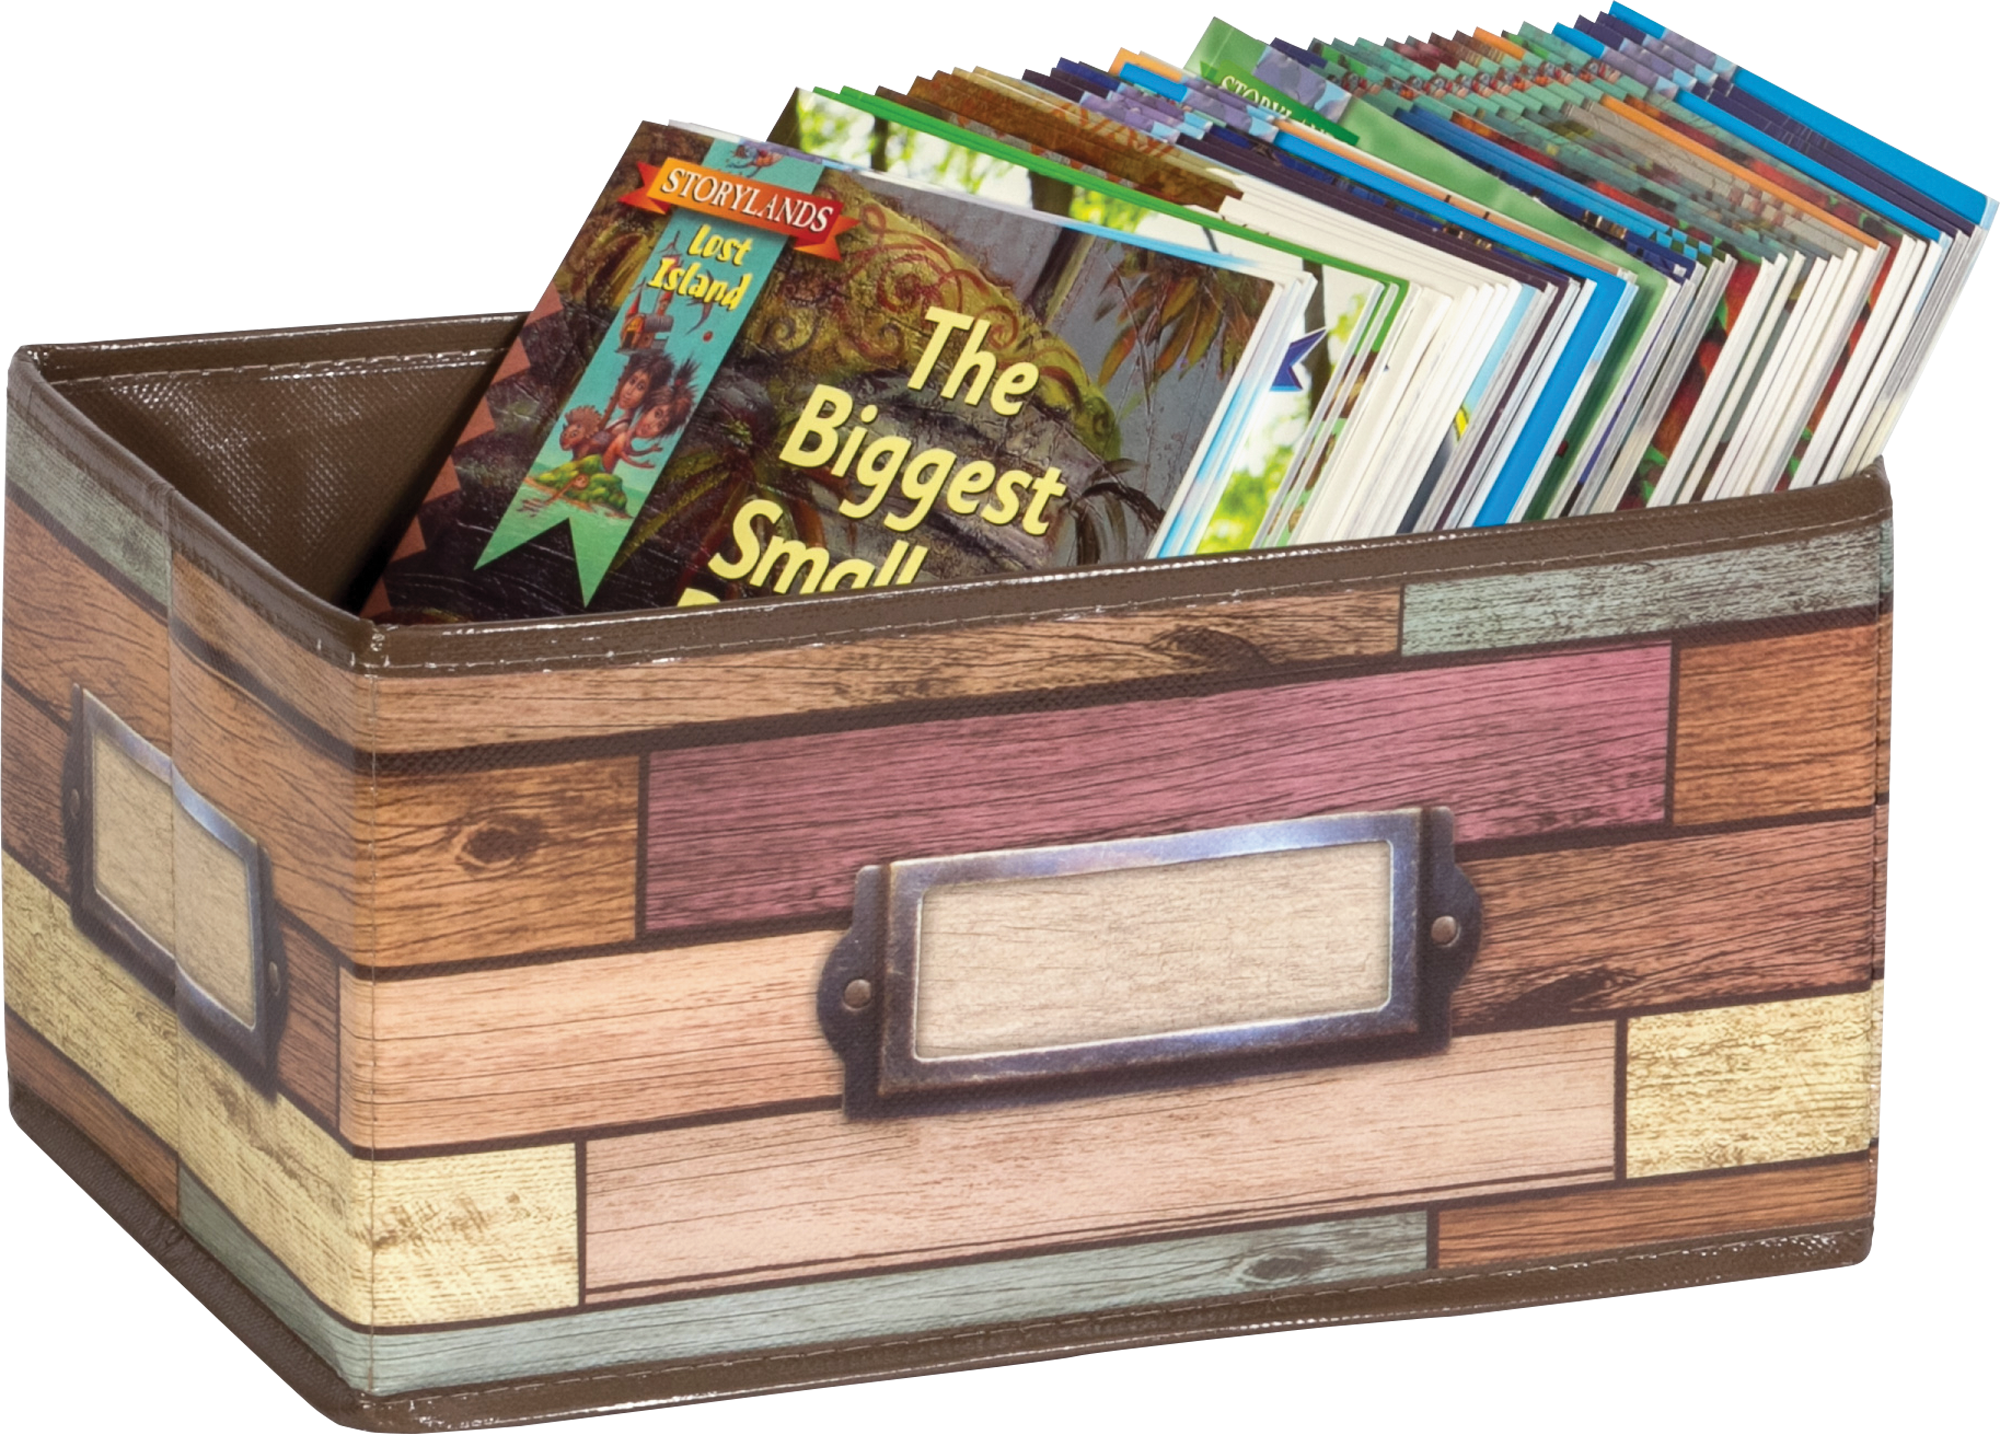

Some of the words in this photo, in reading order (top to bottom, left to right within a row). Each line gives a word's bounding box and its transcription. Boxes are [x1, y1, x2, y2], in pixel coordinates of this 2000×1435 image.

[1221, 75, 1335, 138] STORY
[661, 167, 834, 233] STORYLANDS
[688, 224, 753, 265] Lost
[648, 257, 753, 311] Island
[907, 306, 1039, 416] The
[779, 383, 1067, 536] Biggest
